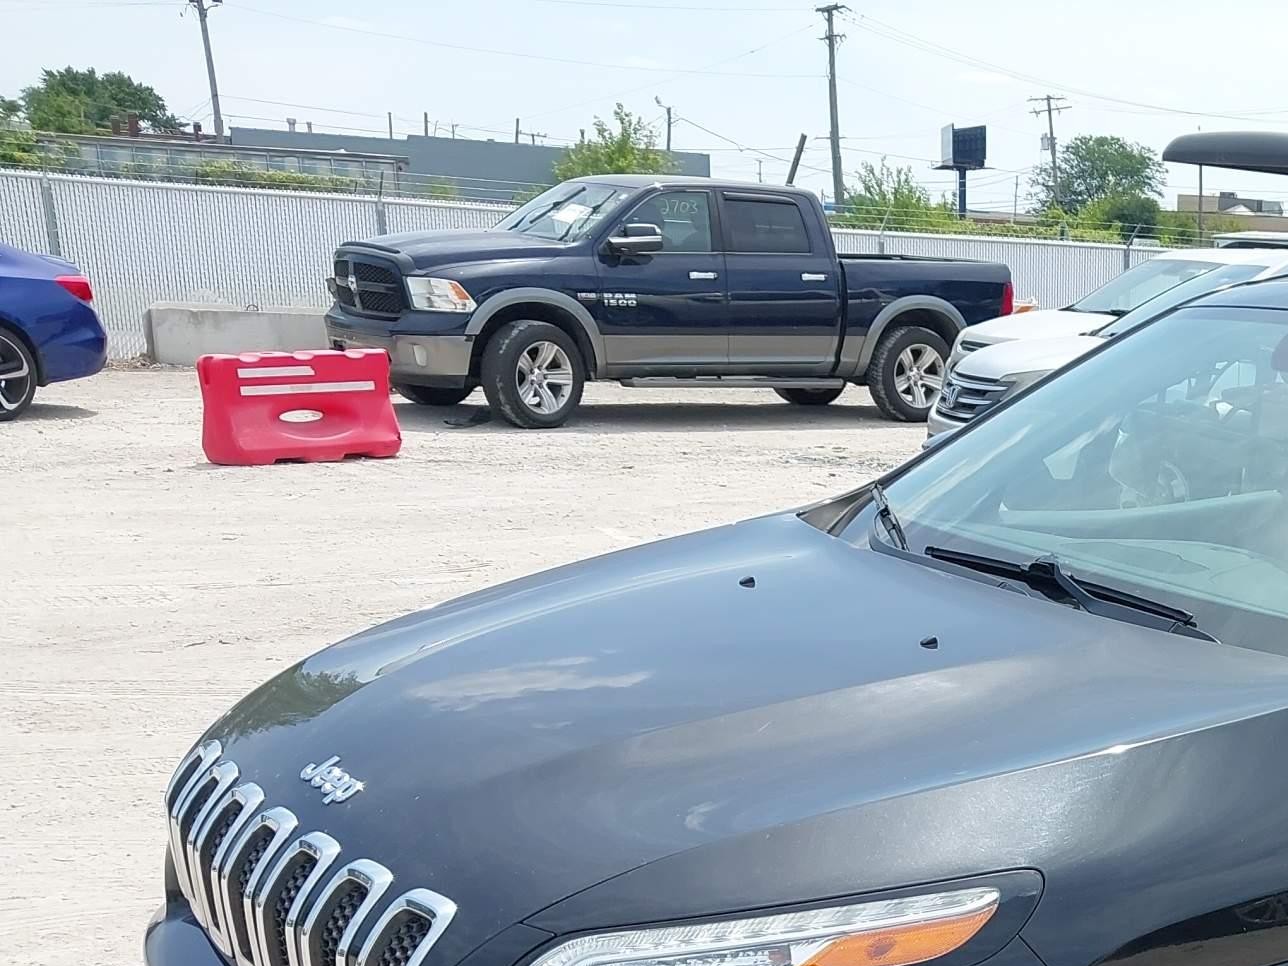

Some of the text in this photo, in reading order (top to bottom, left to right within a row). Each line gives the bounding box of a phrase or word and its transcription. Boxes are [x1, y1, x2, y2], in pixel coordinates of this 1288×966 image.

[660, 197, 698, 215] 2703
[603, 299, 637, 307] 1500
[300, 755, 365, 805] Jeep
